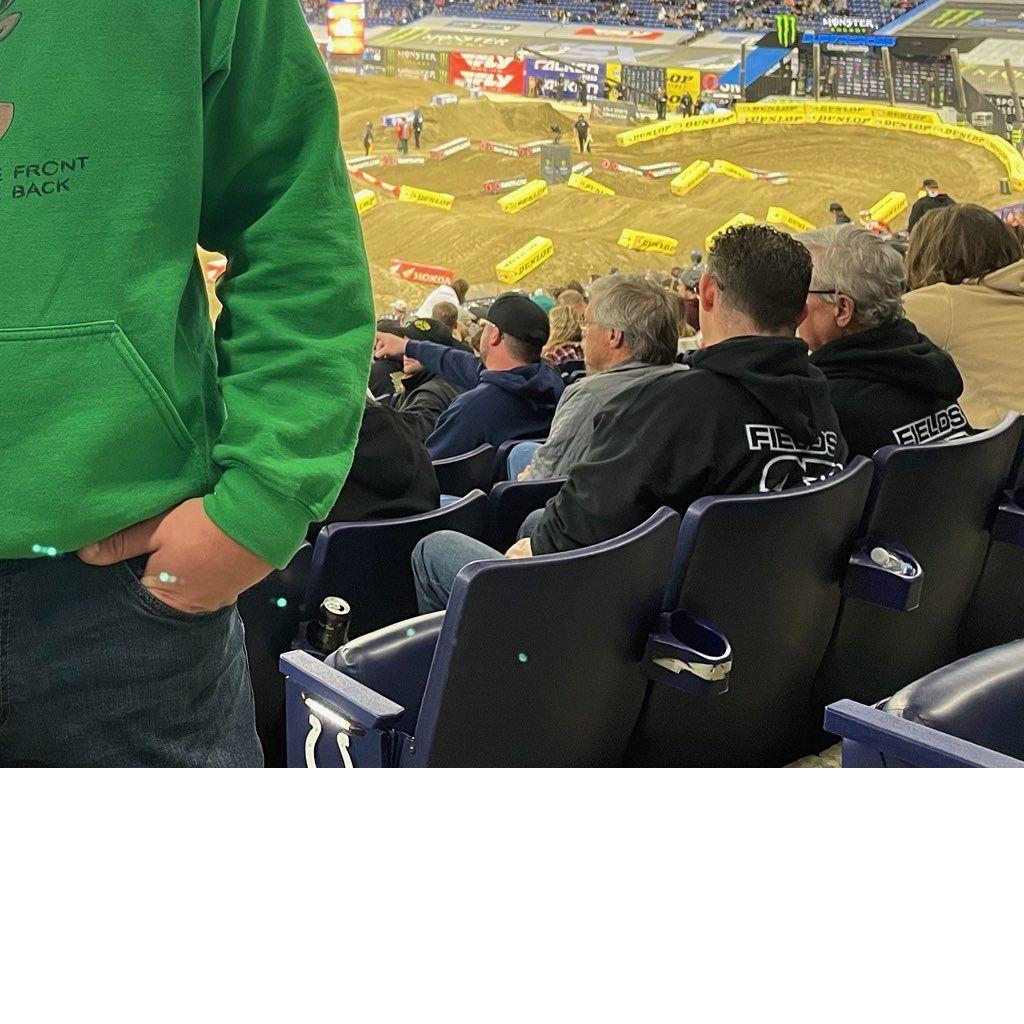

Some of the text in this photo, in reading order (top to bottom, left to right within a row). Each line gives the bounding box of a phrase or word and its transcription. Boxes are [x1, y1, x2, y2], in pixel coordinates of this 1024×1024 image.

[823, 17, 874, 29] MONSTER
[802, 33, 896, 46] SUPERCROSS
[459, 53, 515, 69] FLY
[459, 71, 515, 88] FLY
[685, 115, 733, 128] DUNLOP
[884, 120, 931, 132] DUNLOP
[13, 156, 90, 179] FRONT
[11, 177, 71, 199] BACK
[416, 193, 452, 207] DUNLOP
[517, 244, 553, 276] DUNLOP
[413, 272, 452, 285] HONDA
[893, 403, 967, 445] FIELDS
